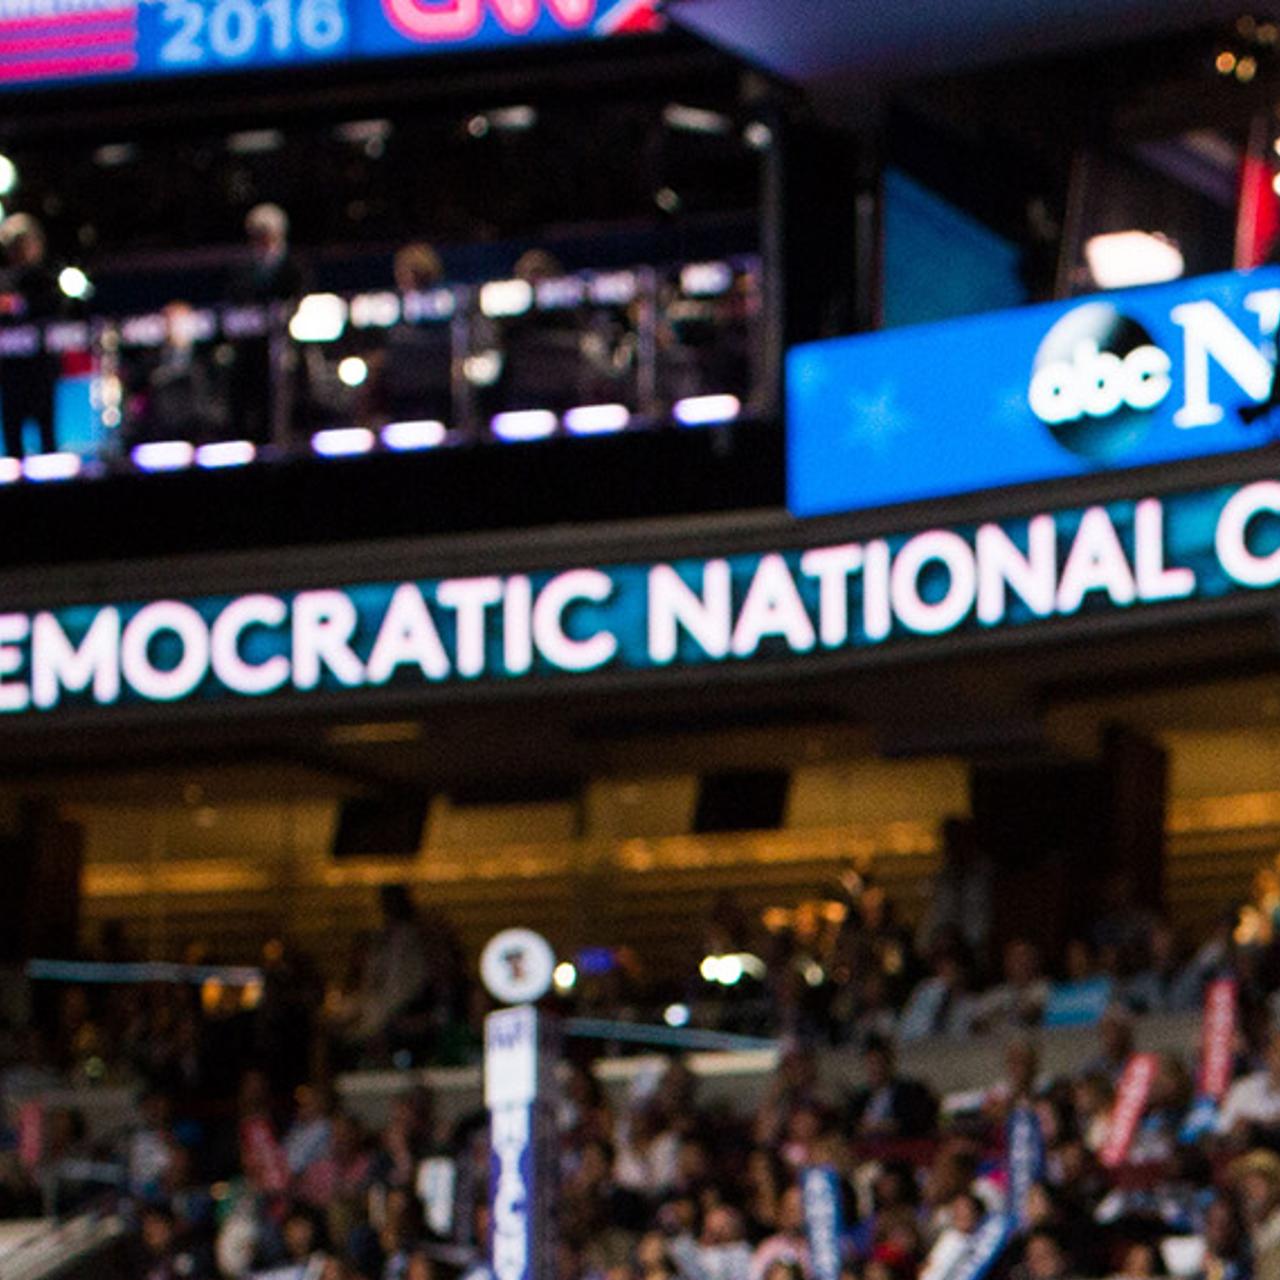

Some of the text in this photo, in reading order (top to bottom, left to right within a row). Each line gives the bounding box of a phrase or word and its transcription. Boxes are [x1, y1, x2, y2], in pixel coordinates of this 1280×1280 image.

[160, 0, 346, 63] 2016
[1029, 338, 1172, 425] abc
[646, 499, 1195, 661] NATIONAL
